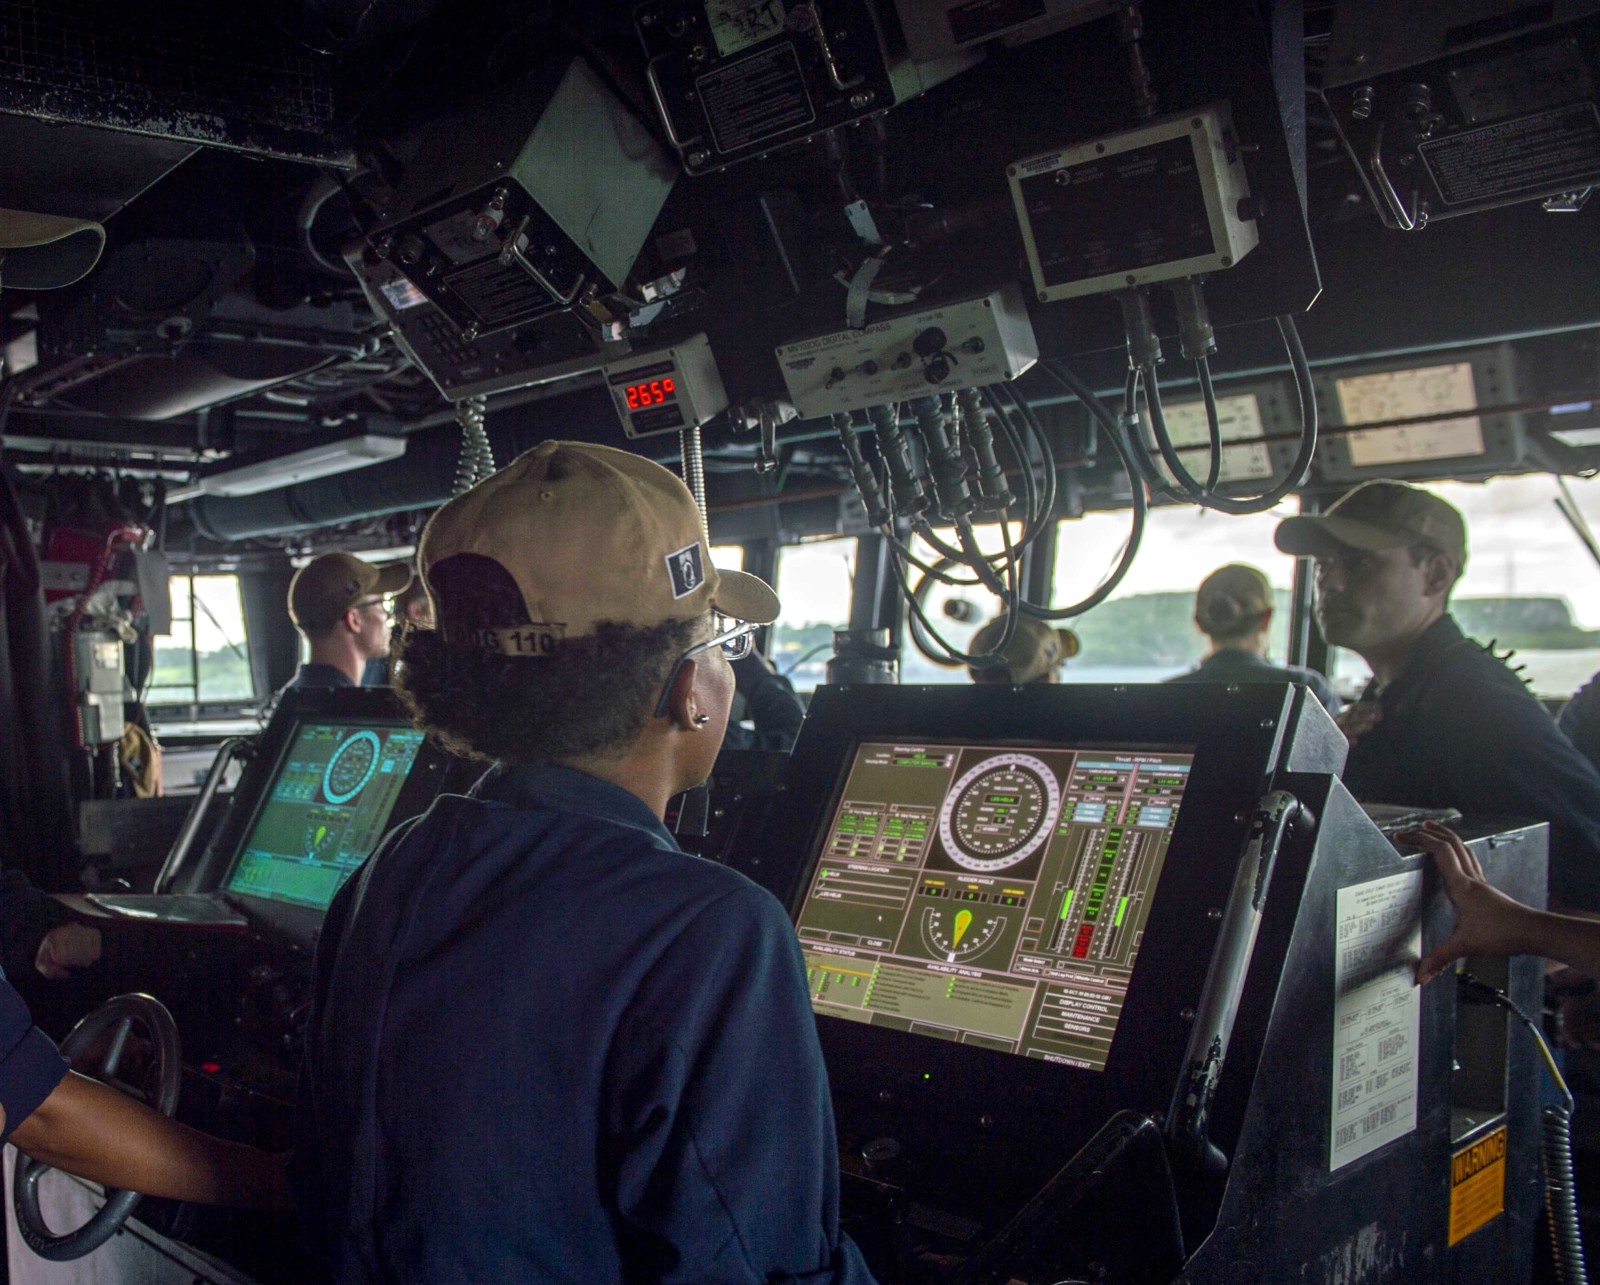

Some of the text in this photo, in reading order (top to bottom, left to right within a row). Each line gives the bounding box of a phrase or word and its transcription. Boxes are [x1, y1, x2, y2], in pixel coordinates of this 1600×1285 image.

[822, 333, 851, 348] DIGITAL
[852, 324, 892, 341] COMPASS
[927, 964, 982, 977] AVAILABILITY ANALYSIS
[1059, 999, 1108, 1013] DISPLAY CONTROL
[1061, 1011, 1100, 1023] MAINTENANCE
[1064, 1022, 1090, 1033] SENSORS
[1044, 1054, 1075, 1065] SHUTDOWN
[1454, 1132, 1505, 1187] WARNING
